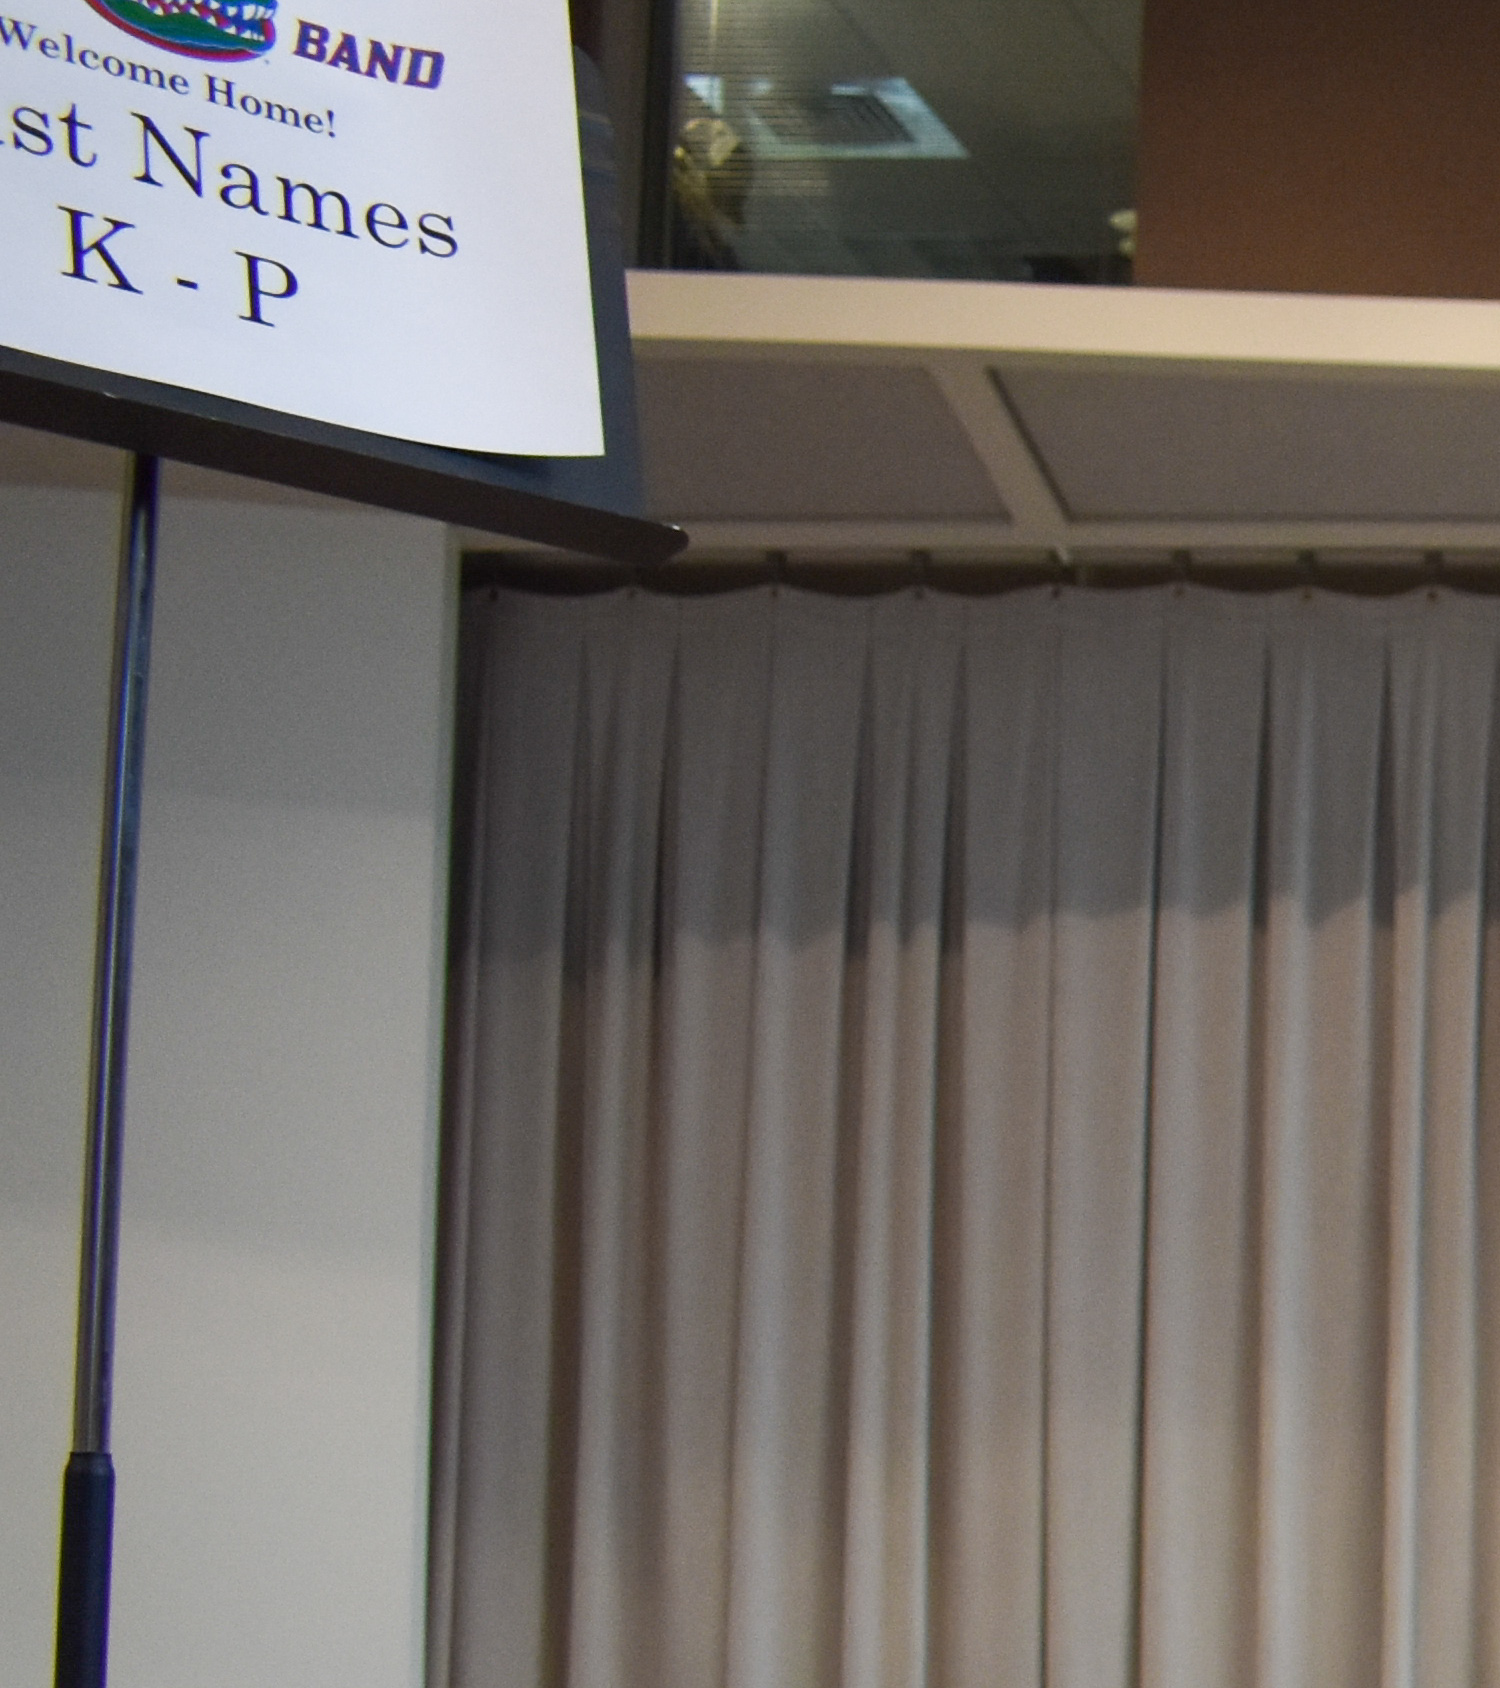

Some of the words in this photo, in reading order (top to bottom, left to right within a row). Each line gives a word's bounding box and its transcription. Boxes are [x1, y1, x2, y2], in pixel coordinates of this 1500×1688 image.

[0, 15, 190, 97] Welcome
[204, 74, 338, 138] Home!
[293, 18, 446, 91] BAND
[0, 101, 98, 169] st
[131, 111, 460, 259] Names
[57, 205, 144, 294] K
[234, 251, 299, 328] P
